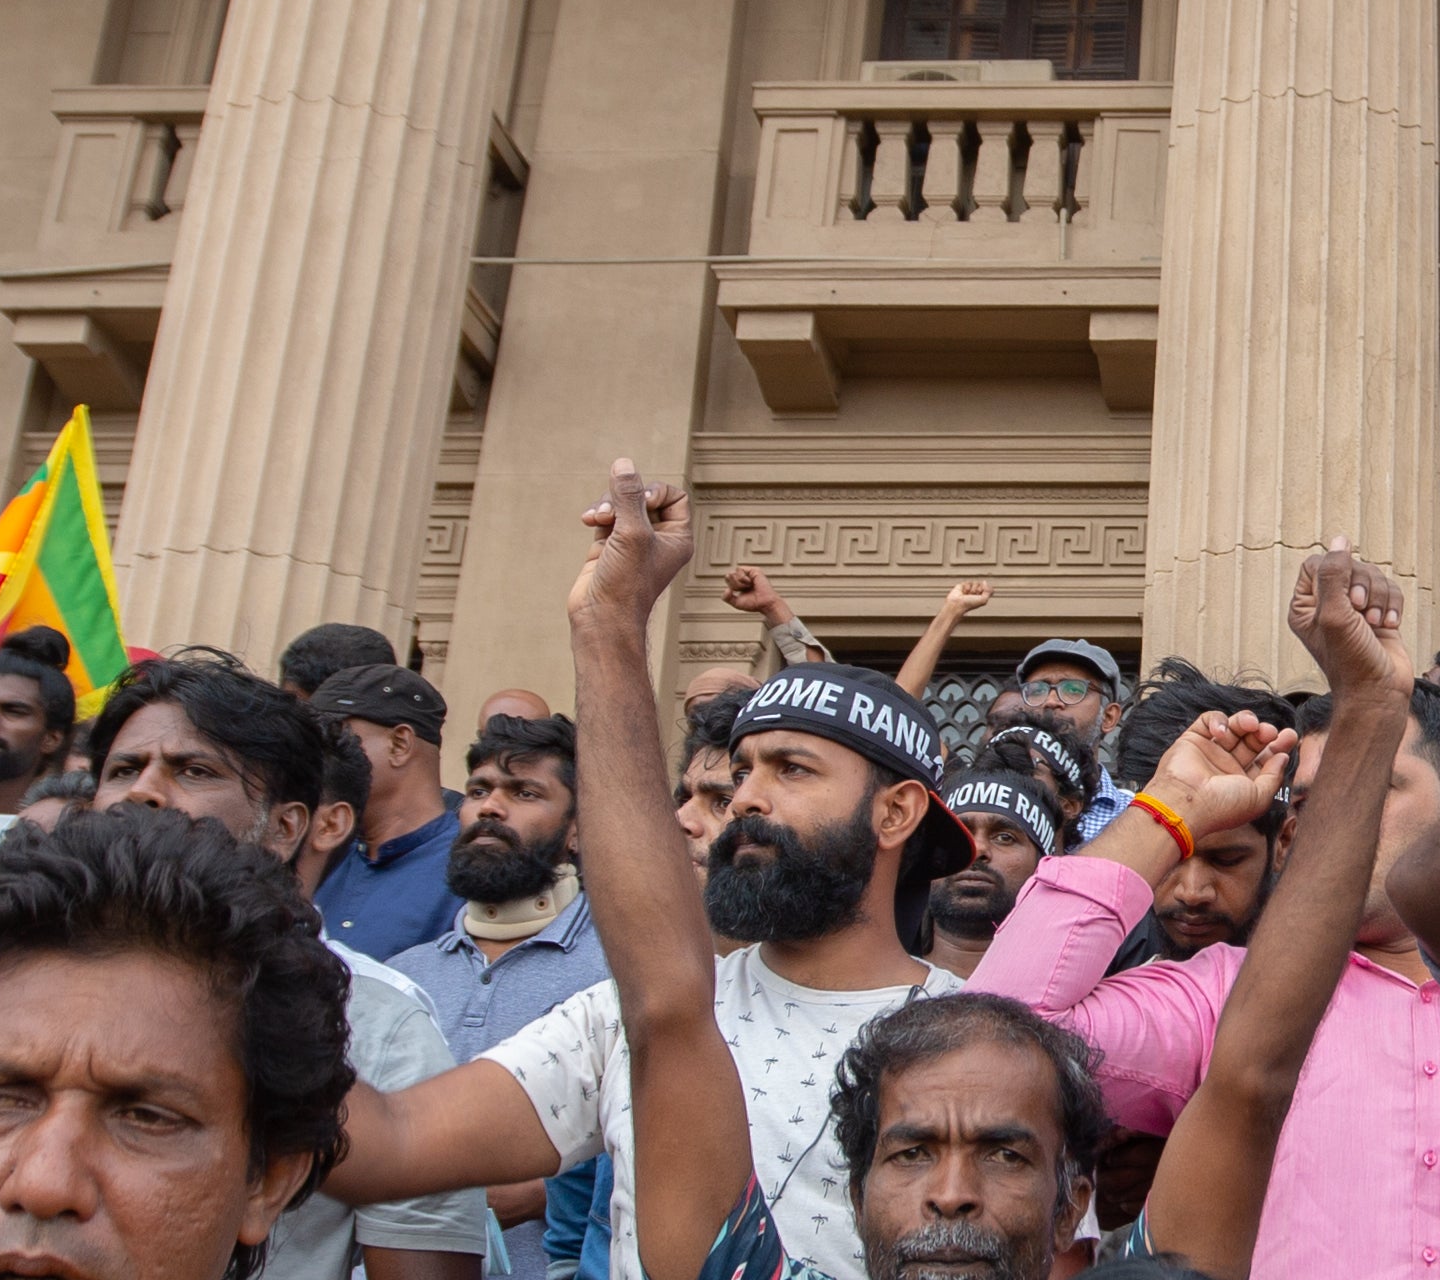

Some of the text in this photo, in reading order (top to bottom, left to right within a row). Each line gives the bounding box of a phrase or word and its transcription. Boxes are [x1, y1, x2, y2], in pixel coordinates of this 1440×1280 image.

[746, 677, 934, 770] HOME RANIL
[946, 781, 1013, 811] HOME
